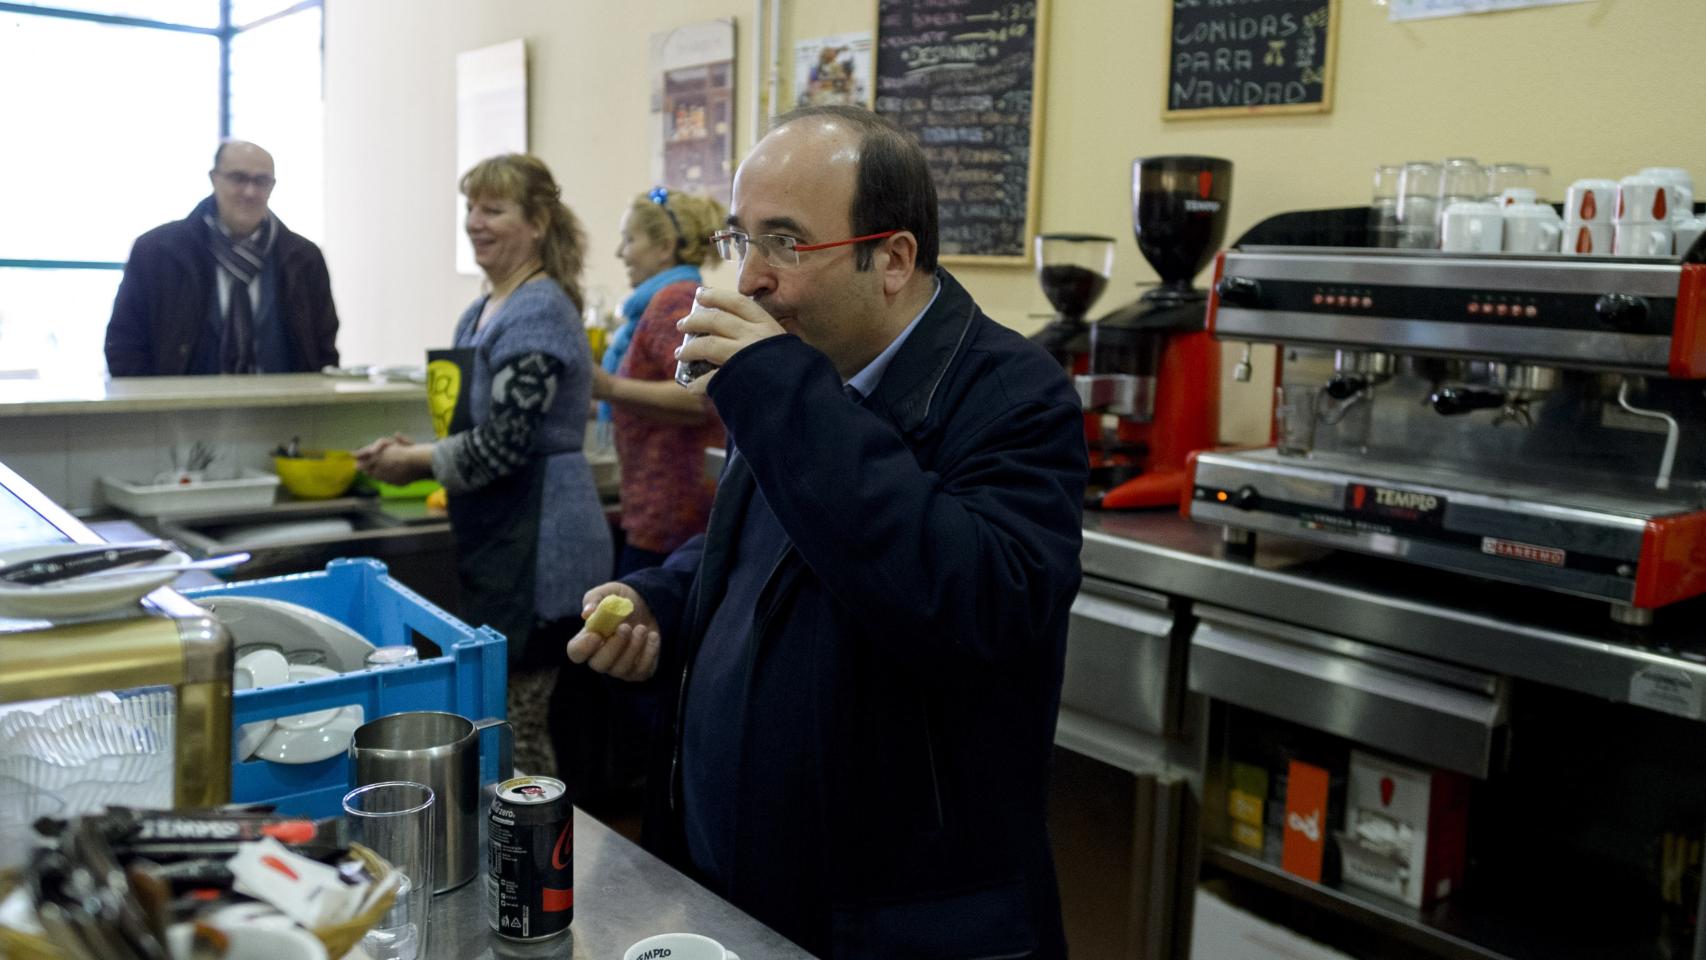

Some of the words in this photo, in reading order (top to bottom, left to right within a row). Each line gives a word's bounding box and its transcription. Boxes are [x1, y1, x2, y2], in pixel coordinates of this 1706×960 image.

[1175, 13, 1298, 45] COMIDAS
[1176, 48, 1252, 74] PARA
[1173, 77, 1307, 107] NAVIDAD
[636, 948, 671, 960] EMPLO
